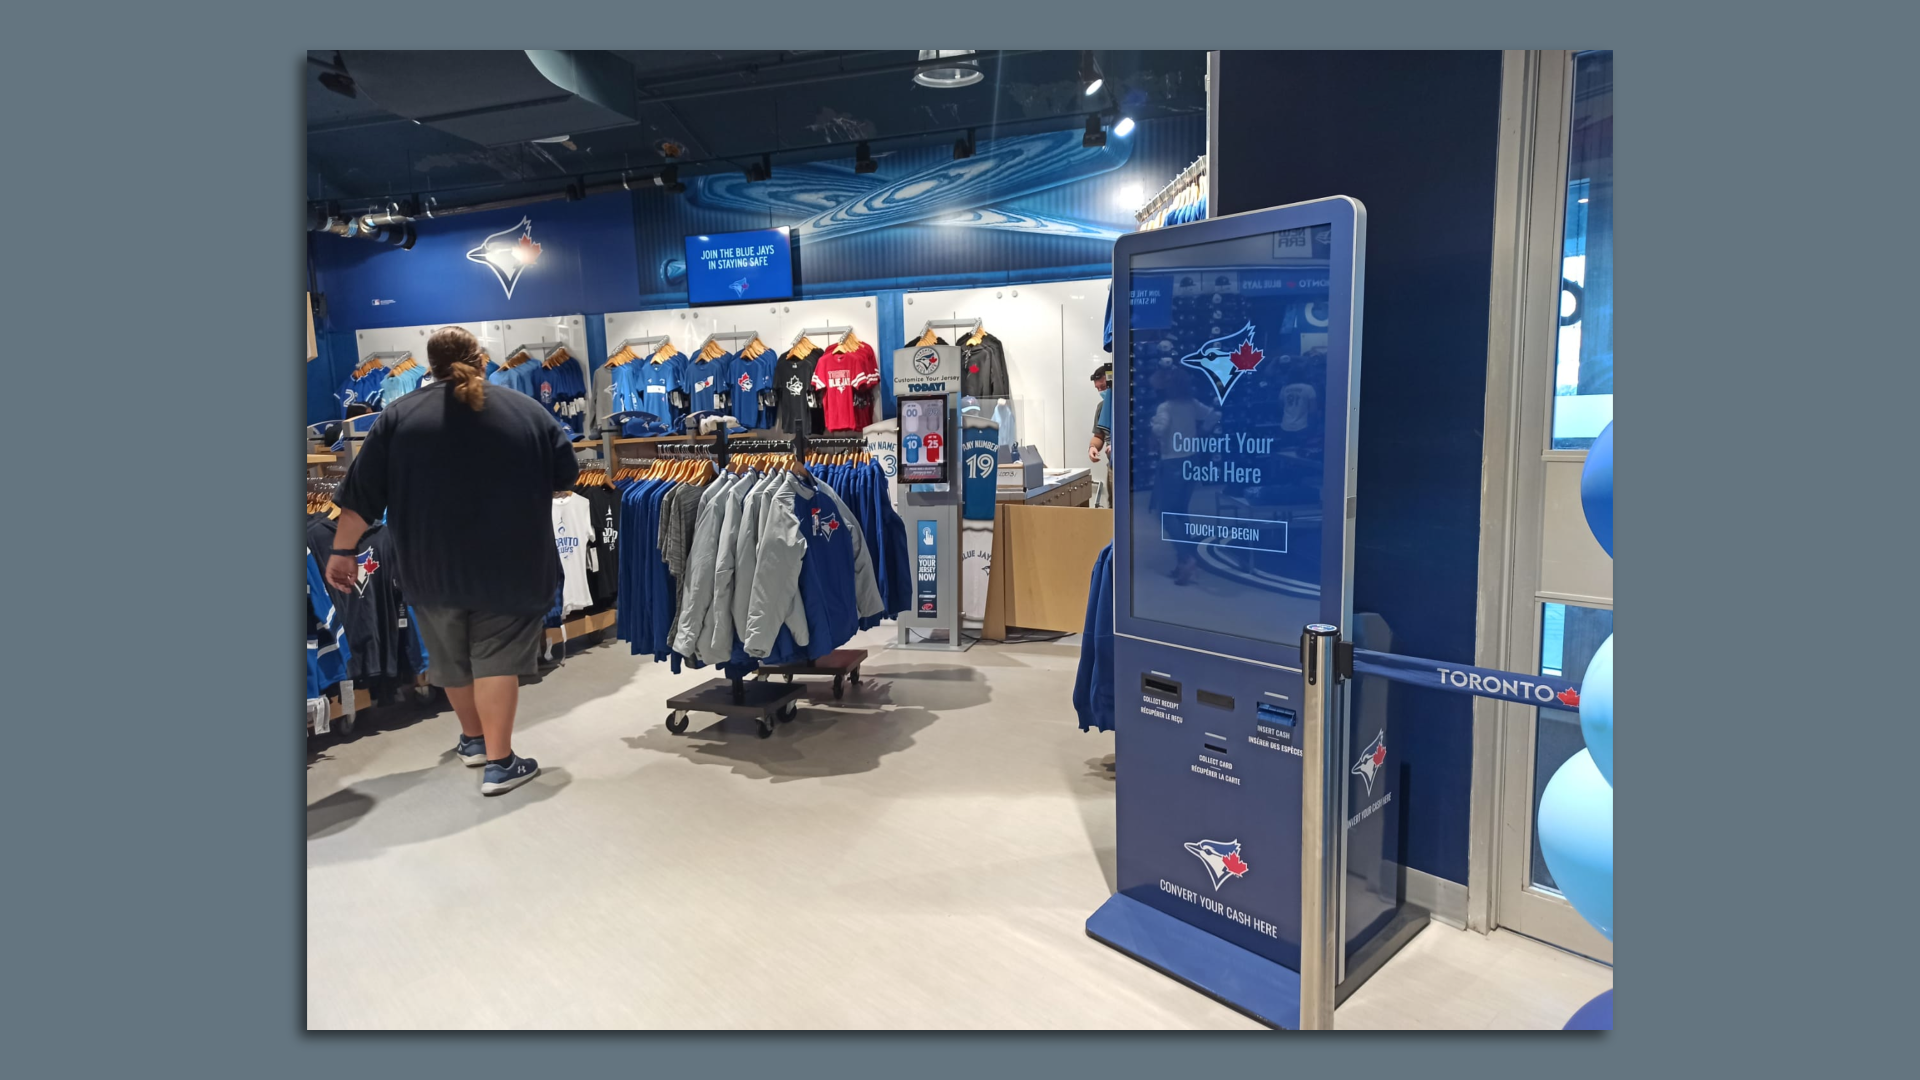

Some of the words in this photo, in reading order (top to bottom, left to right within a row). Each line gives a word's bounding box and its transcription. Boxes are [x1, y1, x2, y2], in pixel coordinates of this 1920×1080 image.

[700, 249, 718, 260] JOIN
[719, 248, 734, 258] THE
[735, 246, 755, 257] BLUE
[756, 244, 775, 256] JAYS
[708, 260, 716, 270] IN
[717, 258, 748, 270] STAYING
[749, 256, 769, 267] SAFE
[908, 382, 946, 393] TODAY!
[906, 408, 918, 418] 00
[877, 441, 897, 452] NAME
[907, 440, 918, 449] 10
[927, 439, 939, 449] 25
[962, 440, 974, 452] ANY
[974, 440, 999, 453] NUMBER
[1172, 431, 1231, 454] Convert
[1236, 432, 1274, 455] Your
[965, 453, 995, 479] 19
[1182, 460, 1218, 482] Cash
[1223, 461, 1262, 484] Here
[1184, 522, 1215, 538] TOUCH
[1217, 525, 1229, 539] TO
[1231, 526, 1260, 542] BEGIN
[918, 559, 936, 567] YOUR
[918, 573, 936, 582] NOW
[1436, 667, 1555, 702] TORONTO
[1143, 695, 1161, 705] COLLECT
[1161, 700, 1179, 710] RECEIPT
[1140, 706, 1165, 719] RÉCUPÉRER
[1257, 725, 1275, 736] INSERT
[1275, 730, 1291, 740] CASH
[1248, 736, 1270, 748] INSÉRER
[1270, 742, 1281, 750] DES
[1281, 744, 1303, 757] ESPÈCES
[1199, 754, 1218, 766] COLLECT
[1219, 760, 1233, 770] CARD
[1191, 764, 1218, 779] RÉCUPÉRER
[1218, 772, 1225, 781] LA
[1225, 775, 1241, 786] CARTE
[1160, 878, 1198, 904] CONVERT
[1199, 894, 1224, 916] YOUR
[1226, 906, 1251, 928] CASH
[1253, 917, 1278, 939] HERE
